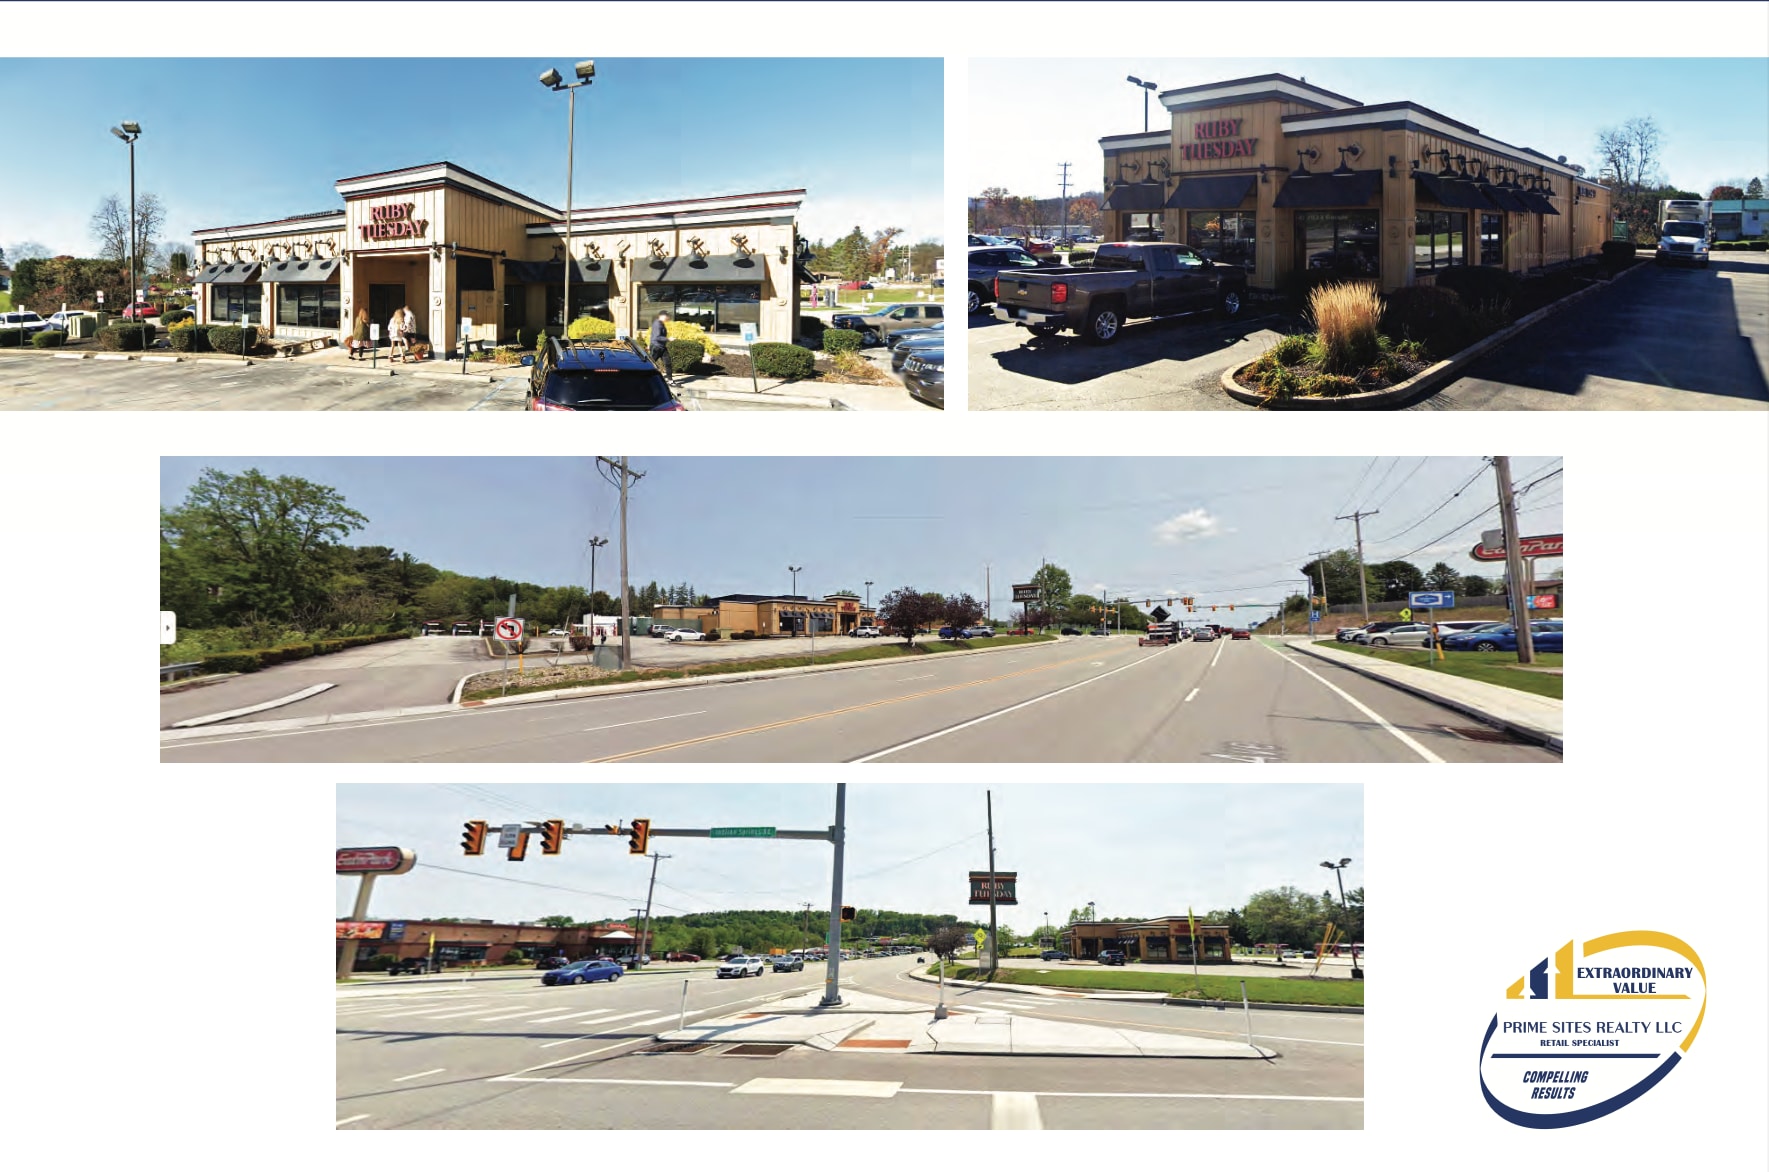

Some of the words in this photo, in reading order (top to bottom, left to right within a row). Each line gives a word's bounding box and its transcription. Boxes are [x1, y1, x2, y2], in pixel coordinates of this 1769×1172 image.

[1194, 118, 1242, 139] RUBY
[1180, 137, 1258, 160] TUESDAY
[370, 202, 415, 221] RUBY
[358, 219, 429, 241] TUESDAY
[981, 882, 1004, 890] RUBY
